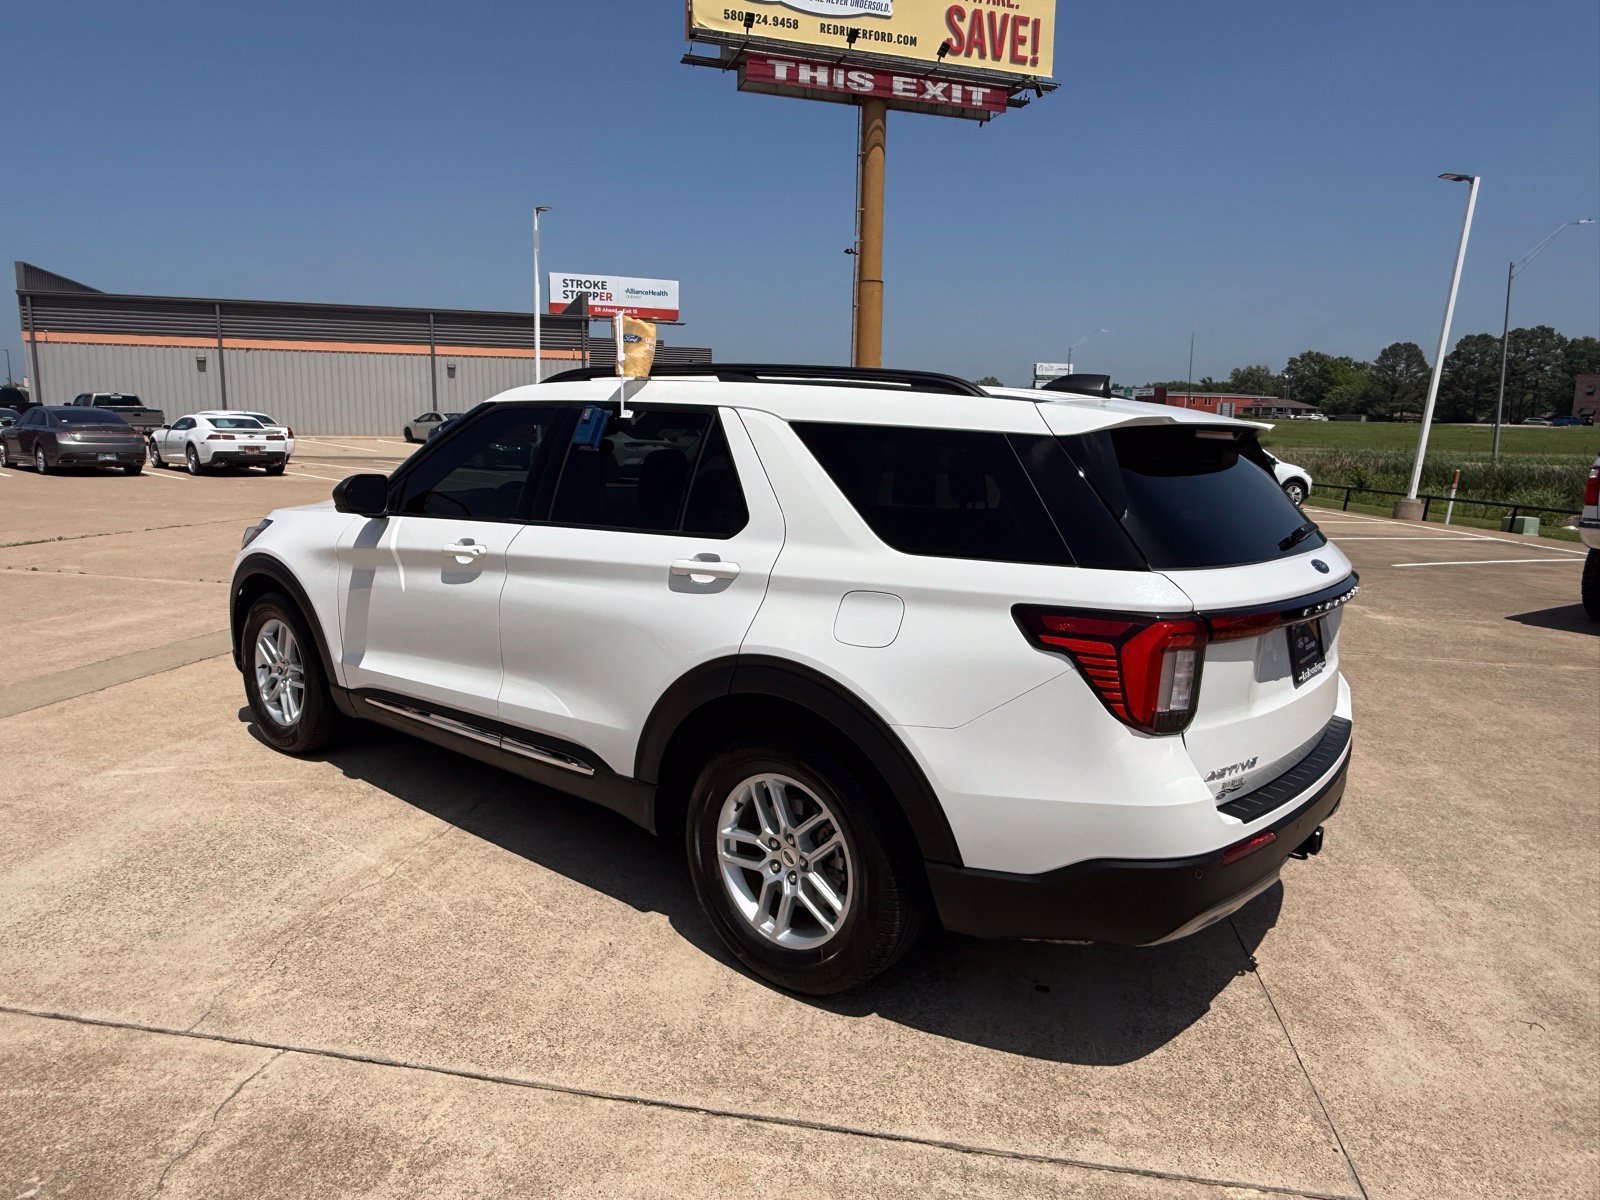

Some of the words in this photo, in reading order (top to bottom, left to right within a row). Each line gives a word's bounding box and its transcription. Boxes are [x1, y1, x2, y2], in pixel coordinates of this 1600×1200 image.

[945, 4, 1041, 67] SAVE!
[766, 59, 875, 92] THIS
[892, 75, 991, 106] EXIT
[562, 278, 608, 290] STROKE
